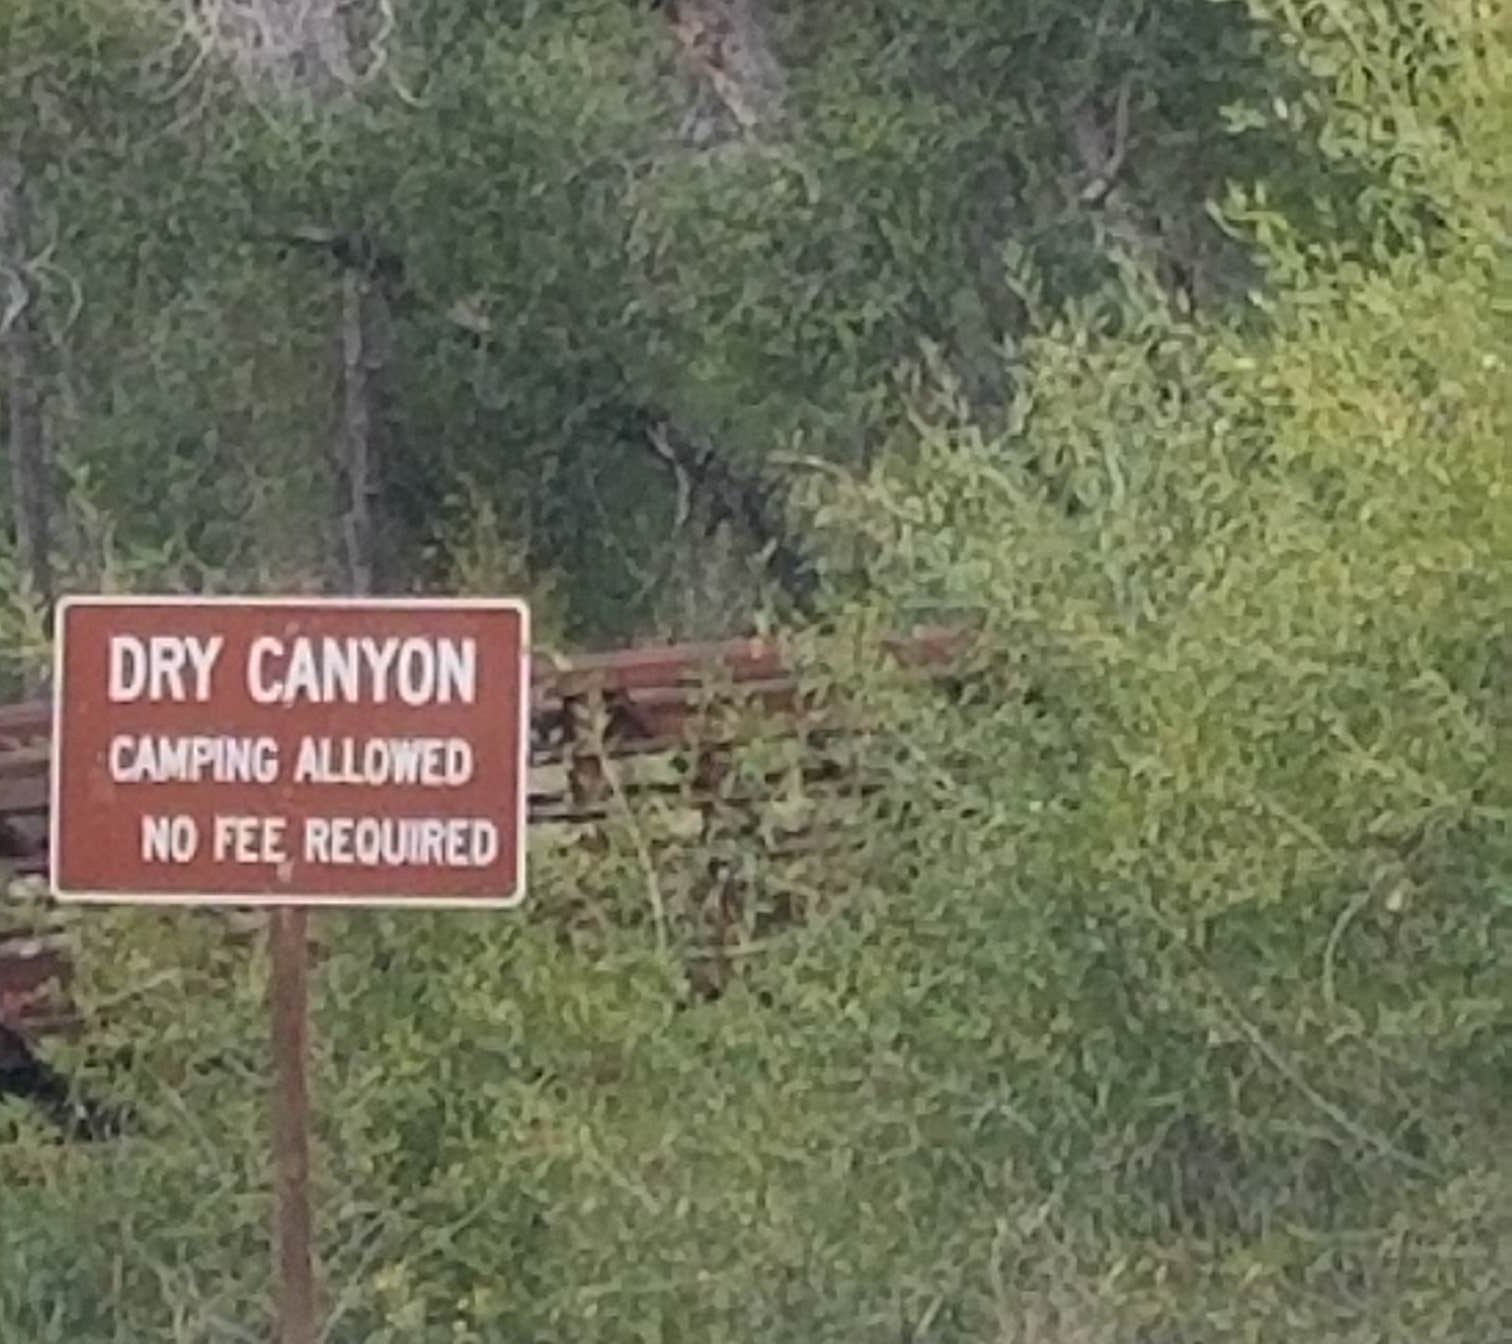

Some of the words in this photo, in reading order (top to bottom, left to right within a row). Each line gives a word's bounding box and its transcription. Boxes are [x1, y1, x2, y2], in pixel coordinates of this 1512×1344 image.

[108, 634, 224, 702] DRY
[247, 635, 477, 706] CANYON
[109, 734, 279, 783] CAMPING
[293, 735, 473, 786] ALLOWED
[142, 814, 198, 863] NO
[213, 815, 287, 864] FEE
[304, 816, 498, 867] REQUIRED
